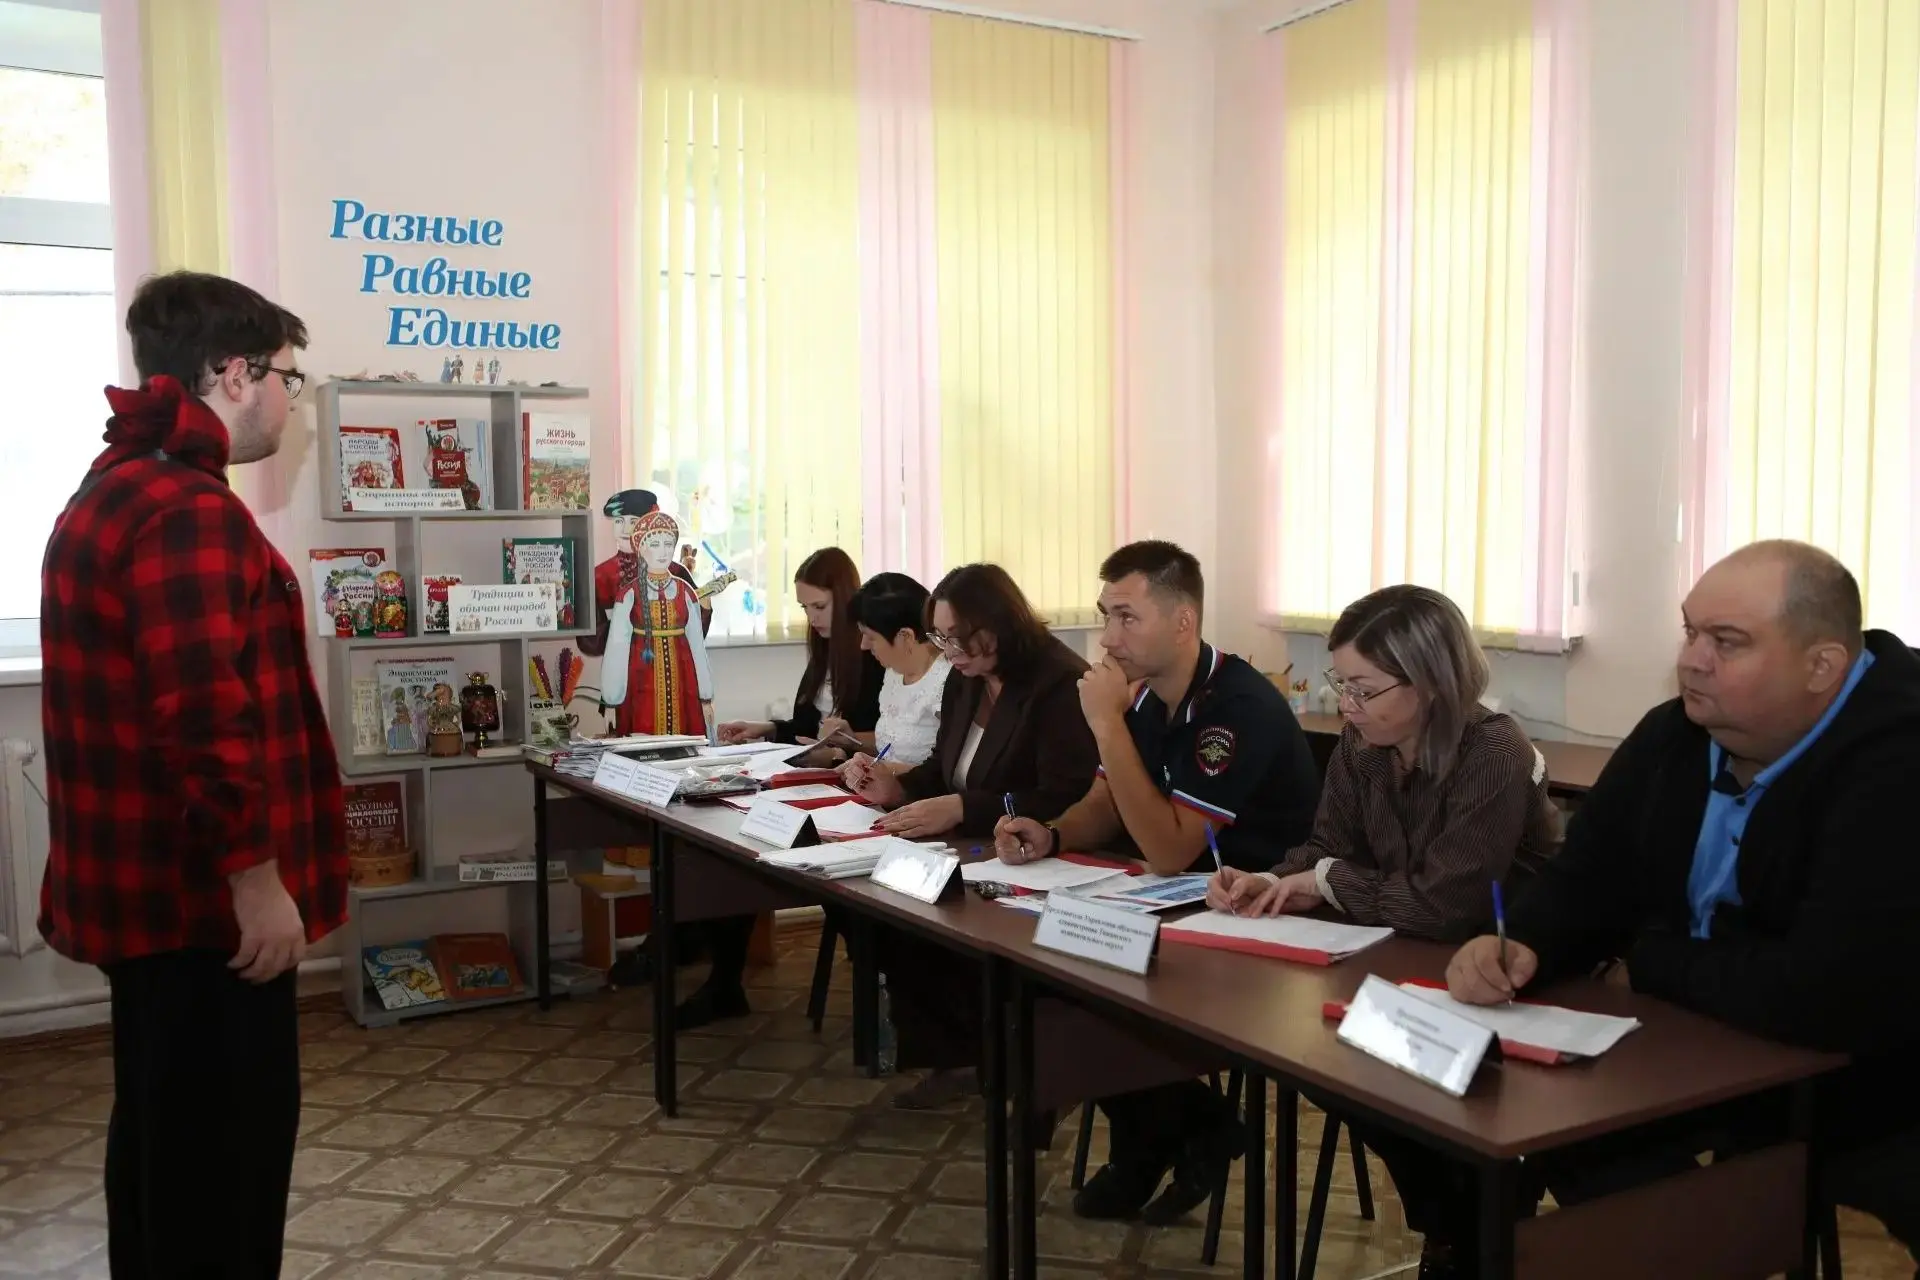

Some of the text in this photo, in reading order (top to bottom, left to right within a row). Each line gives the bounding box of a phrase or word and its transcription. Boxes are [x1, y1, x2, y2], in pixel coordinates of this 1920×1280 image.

[329, 199, 504, 246] Разные
[359, 253, 532, 298] Равные
[386, 306, 561, 350] Единые
[546, 428, 576, 439] ЖИЗНЬ
[535, 438, 586, 447] русского города
[470, 588, 534, 600] Традиции и
[459, 602, 546, 615] обычаи народов
[484, 615, 523, 625] России
